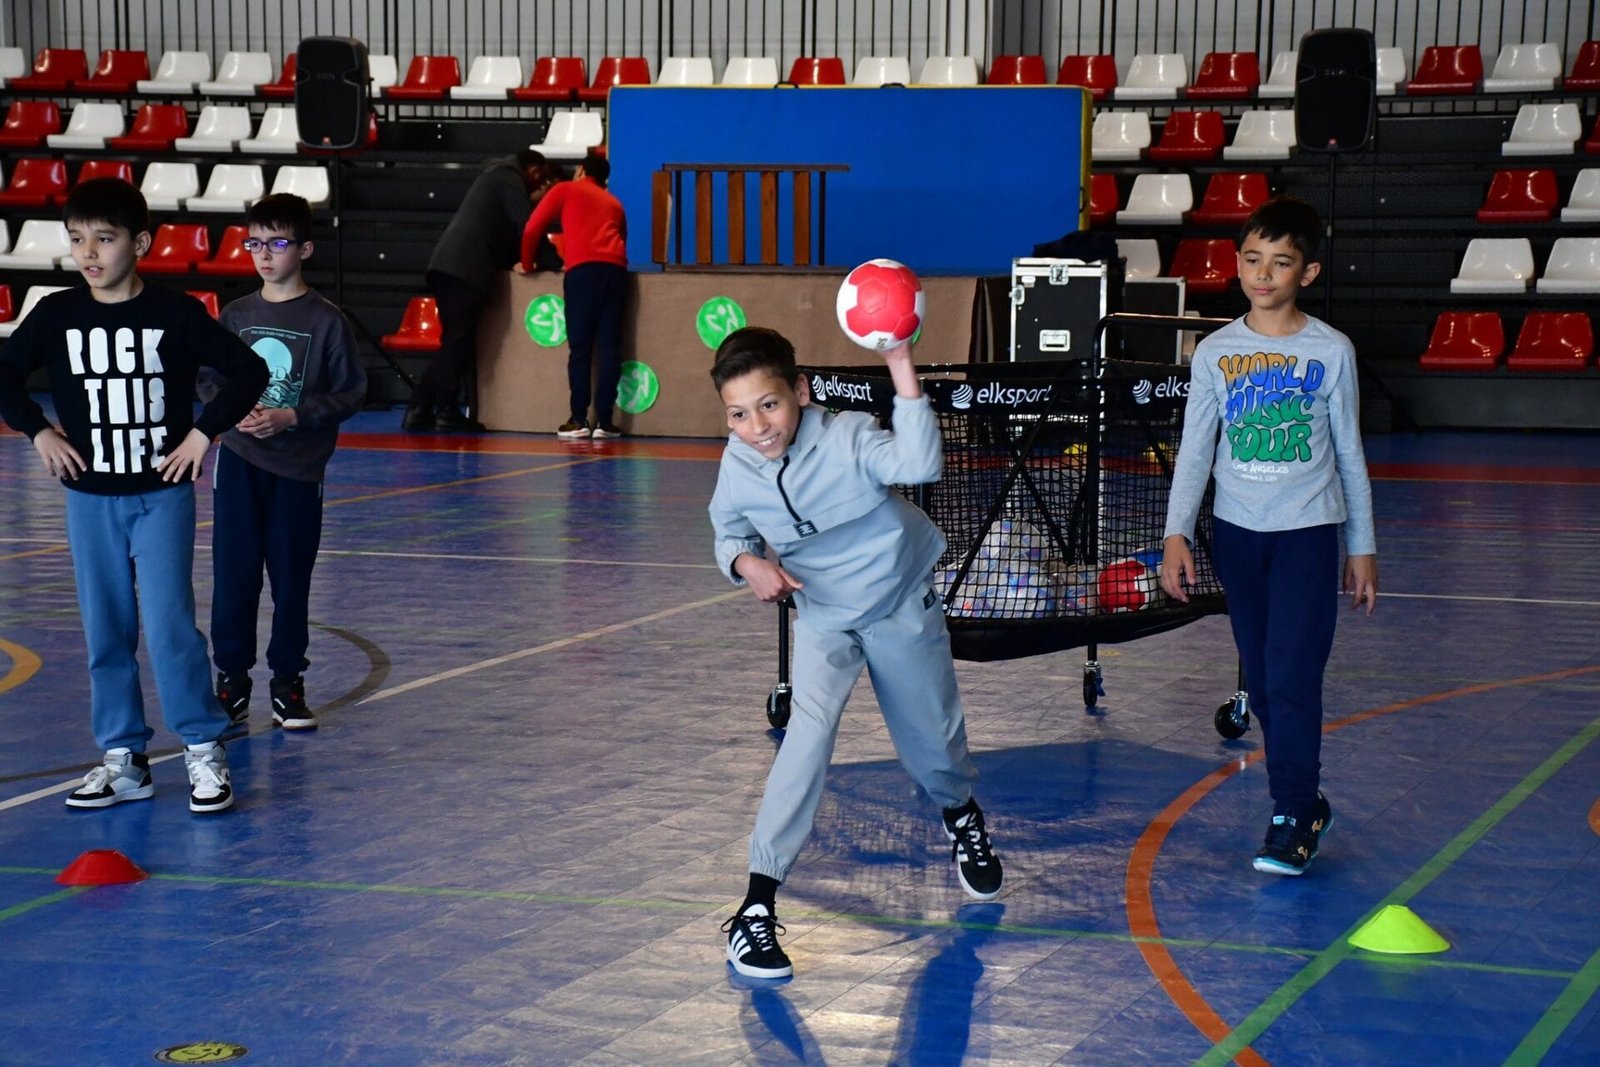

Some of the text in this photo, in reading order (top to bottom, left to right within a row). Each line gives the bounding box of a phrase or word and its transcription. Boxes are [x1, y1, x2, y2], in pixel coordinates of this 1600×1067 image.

[66, 327, 165, 375] ROCK
[825, 375, 874, 403] elksport
[1154, 375, 1192, 398] elks
[1218, 352, 1325, 393] WORLD
[84, 377, 166, 425] THIS
[976, 381, 1053, 408] elksport
[1225, 386, 1315, 427] MUSIC
[91, 426, 168, 474] LIFE
[1227, 424, 1312, 462] TOUR
